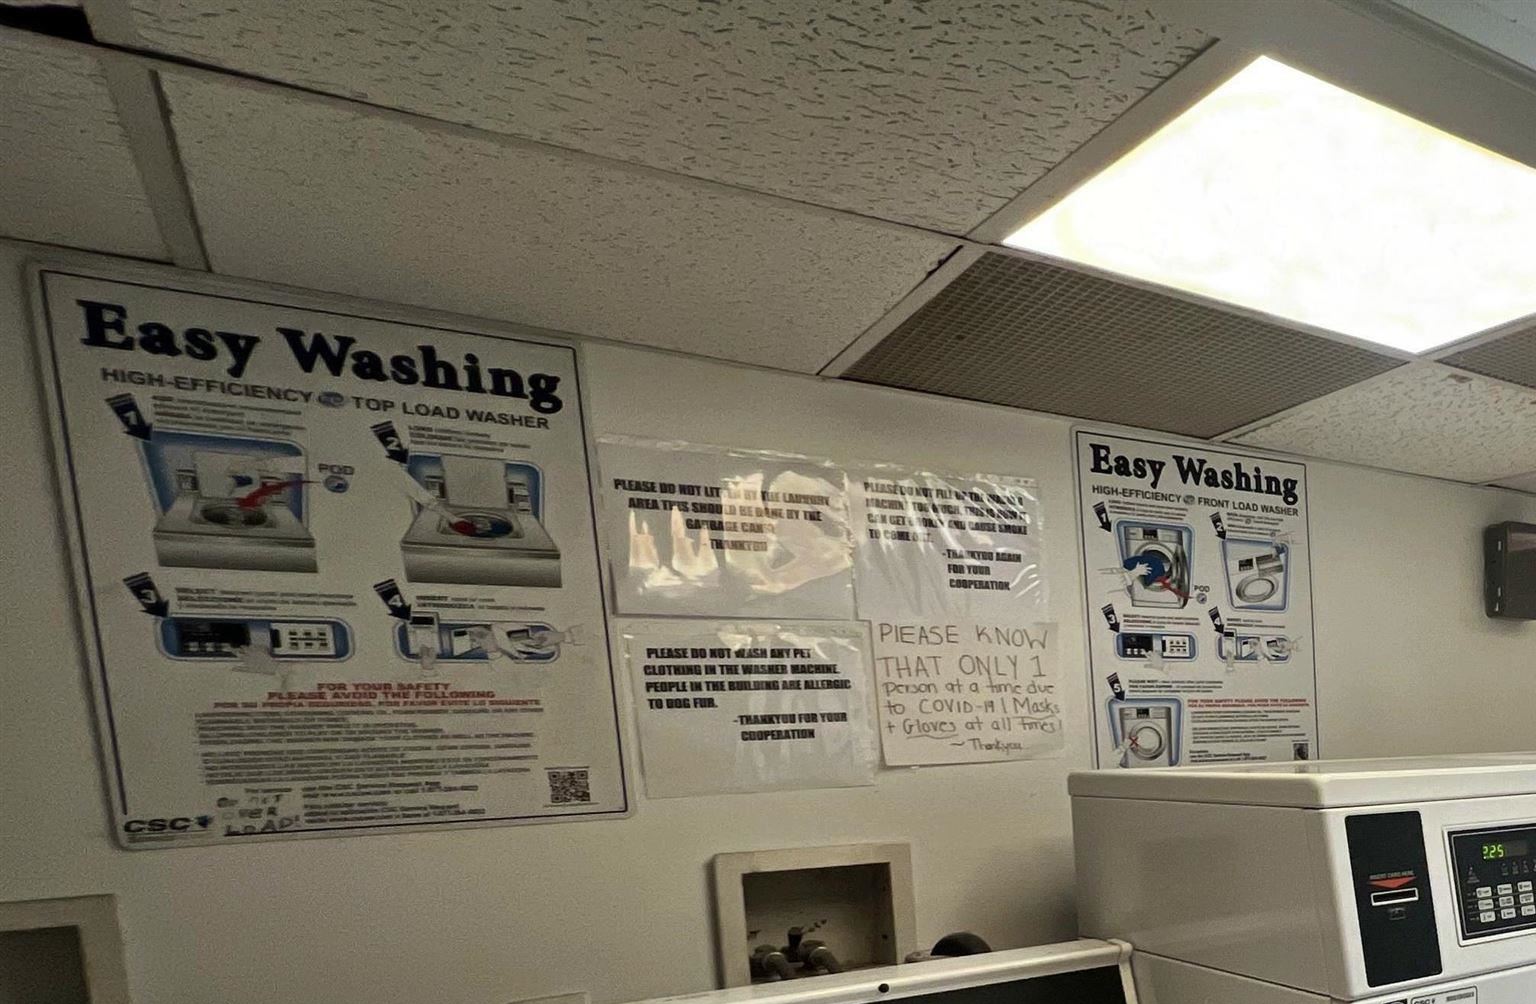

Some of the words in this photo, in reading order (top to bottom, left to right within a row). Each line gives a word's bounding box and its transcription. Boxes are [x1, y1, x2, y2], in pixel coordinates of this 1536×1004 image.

[76, 299, 261, 378] Easy
[275, 326, 563, 414] Washing
[100, 367, 315, 404] HIGH-EFFICIENCY
[351, 395, 396, 412] TOP
[402, 401, 460, 420] LOAD
[465, 409, 550, 430] WASHER
[1088, 443, 1166, 490] Easy
[1172, 455, 1299, 505] Washing
[613, 478, 658, 493] PLEASE
[659, 482, 677, 495] DO
[679, 484, 702, 497] NOT
[628, 497, 660, 510] AREA
[786, 508, 800, 520] BY
[803, 510, 823, 521] THE
[1091, 485, 1182, 504] HIGH-EFFICIENCY
[1198, 497, 1230, 509] FRONT
[1233, 501, 1259, 512] LOAD
[1260, 504, 1299, 517] WASHER
[998, 524, 1028, 536] SMOKE
[948, 563, 965, 575] FOR
[967, 564, 991, 576] YOUR
[949, 579, 1011, 591] COOPERATION
[975, 624, 1048, 649] KNOW
[647, 647, 689, 659] PLEASE
[691, 648, 708, 659] DO
[710, 648, 732, 659] NOT
[770, 648, 792, 658] ANY
[793, 648, 811, 659] PET
[644, 664, 702, 676] CLOTHING
[704, 665, 716, 675] IN
[719, 665, 739, 675] THE
[741, 664, 788, 675] WASHER
[876, 655, 942, 679] THAT
[958, 654, 1018, 681] ONLY
[1029, 655, 1047, 677] 1
[645, 681, 687, 692] PEOPLE
[690, 681, 703, 692] IN
[705, 681, 727, 692] THE
[728, 680, 780, 691] BUILDING
[781, 680, 802, 690] ARE
[804, 679, 852, 690] ALLERGIC
[882, 681, 938, 697] person
[944, 678, 964, 694] at
[969, 682, 980, 693] a
[985, 675, 1022, 693] time
[1026, 680, 1055, 694] due
[648, 698, 664, 710] TO
[666, 698, 691, 709] DOG
[693, 697, 719, 709] FUR.
[884, 700, 906, 715] to
[1012, 697, 1060, 715] Masks
[798, 713, 818, 724] FOR
[819, 712, 848, 723] YOUR
[902, 718, 957, 735] Gloves
[964, 717, 984, 731] at
[991, 717, 1011, 731] all
[741, 729, 816, 741] COOPERATION
[124, 817, 191, 833] CSC
